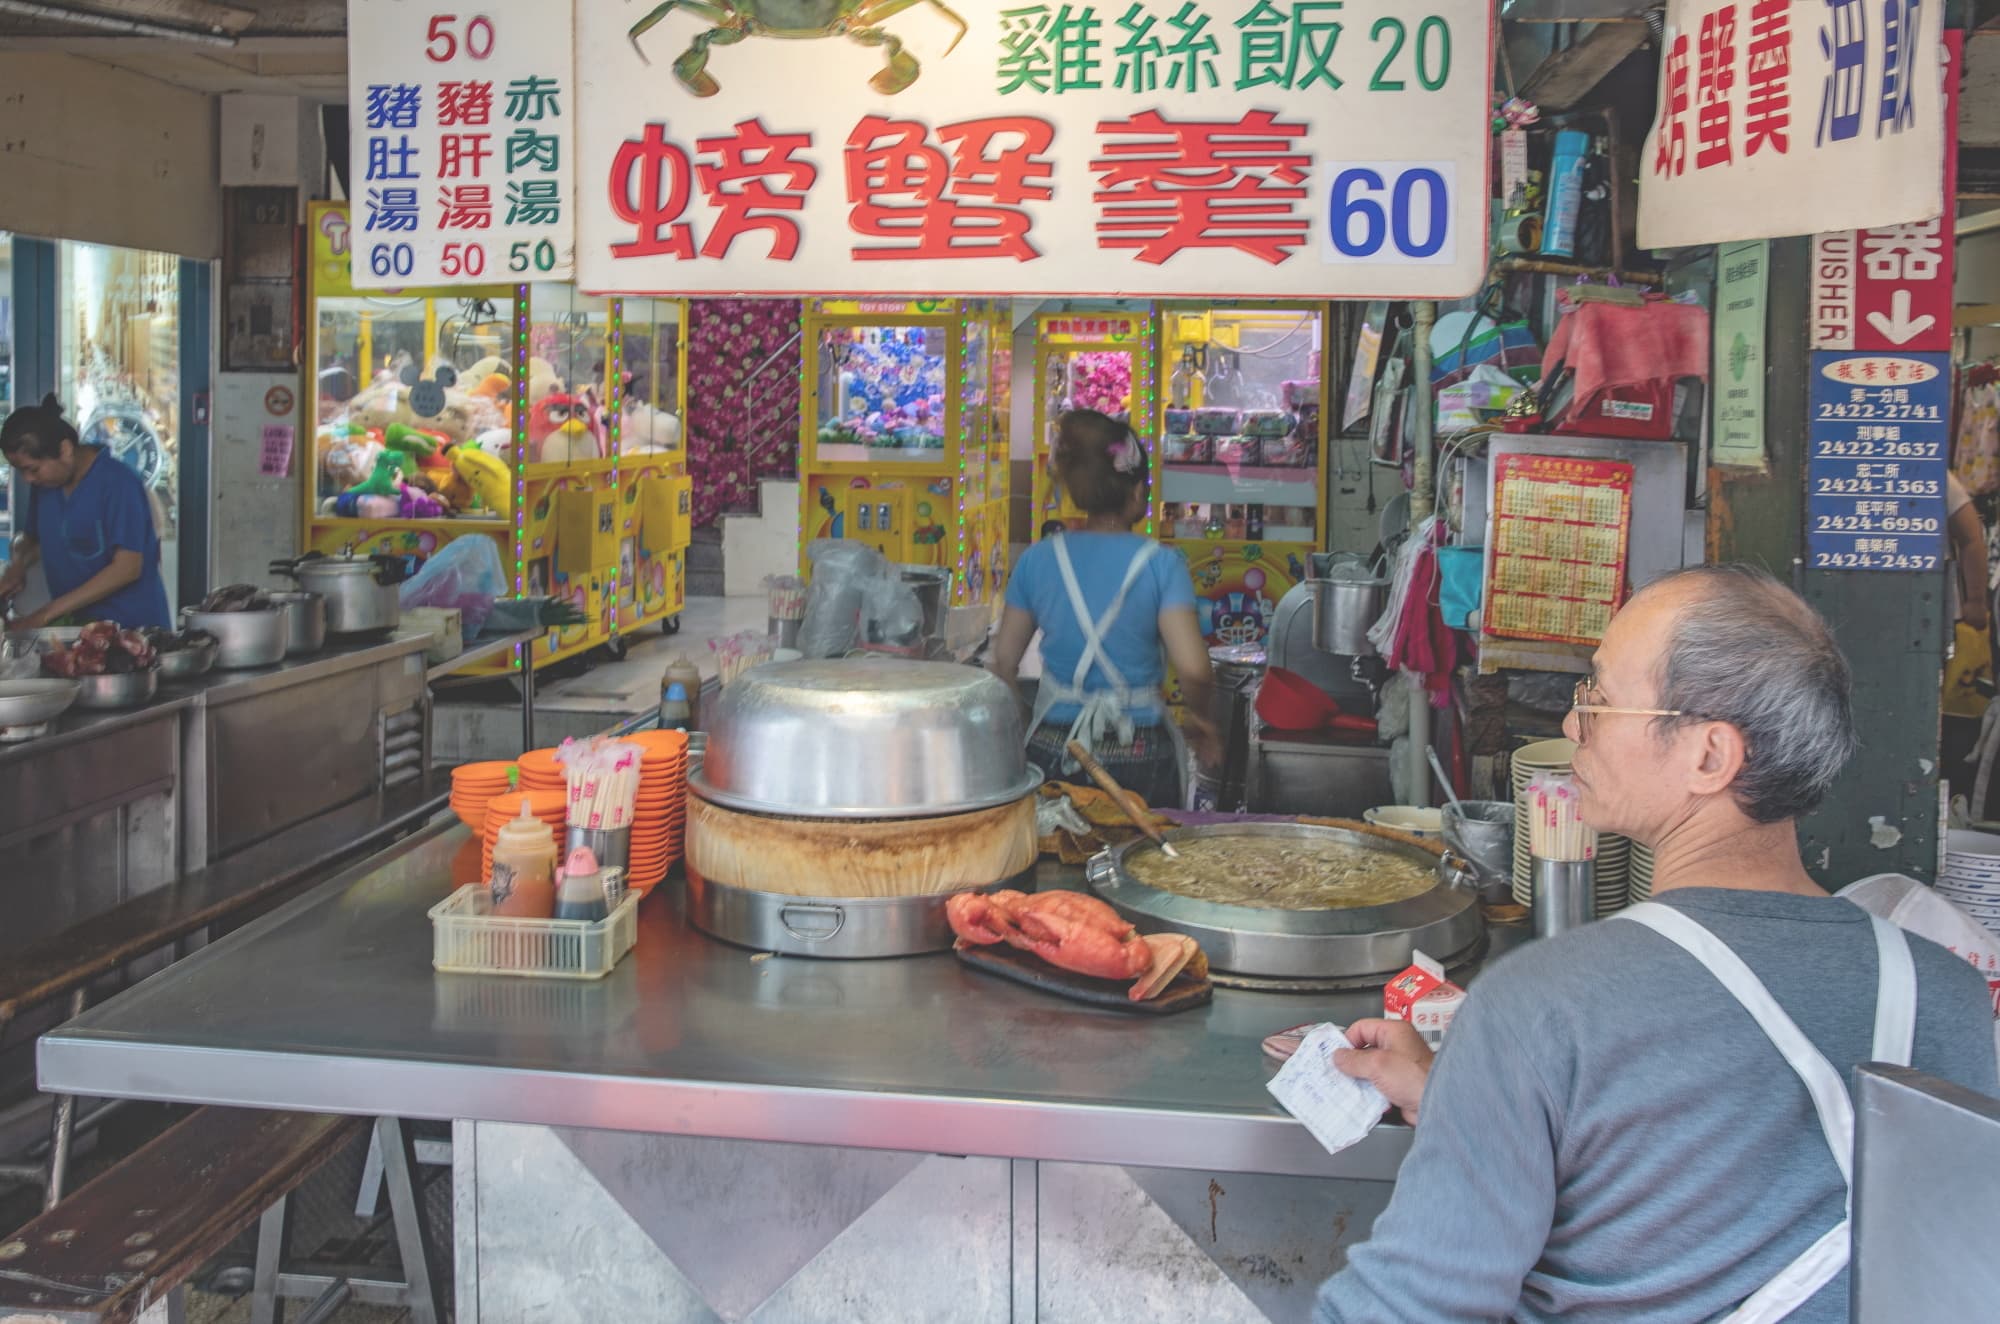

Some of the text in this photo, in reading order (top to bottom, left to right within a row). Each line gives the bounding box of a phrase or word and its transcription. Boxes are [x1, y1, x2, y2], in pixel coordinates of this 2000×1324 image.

[425, 14, 495, 62] 50
[1369, 15, 1451, 91] 20
[364, 82, 421, 276] 豬肚湯 60
[436, 80, 493, 277] 豬肝湯 50
[504, 75, 561, 271] 赤肉湯 50
[608, 110, 1312, 265] 螃蟹羹
[1330, 168, 1448, 258] 60
[1819, 231, 1849, 341] UISHER
[1819, 403, 1939, 419] 2422-2741
[1818, 440, 1940, 456] 2422-2637
[1817, 478, 1939, 494] 2424-1363
[1816, 515, 1939, 532] 2424-6950
[1816, 552, 1937, 569] 2424-2437
